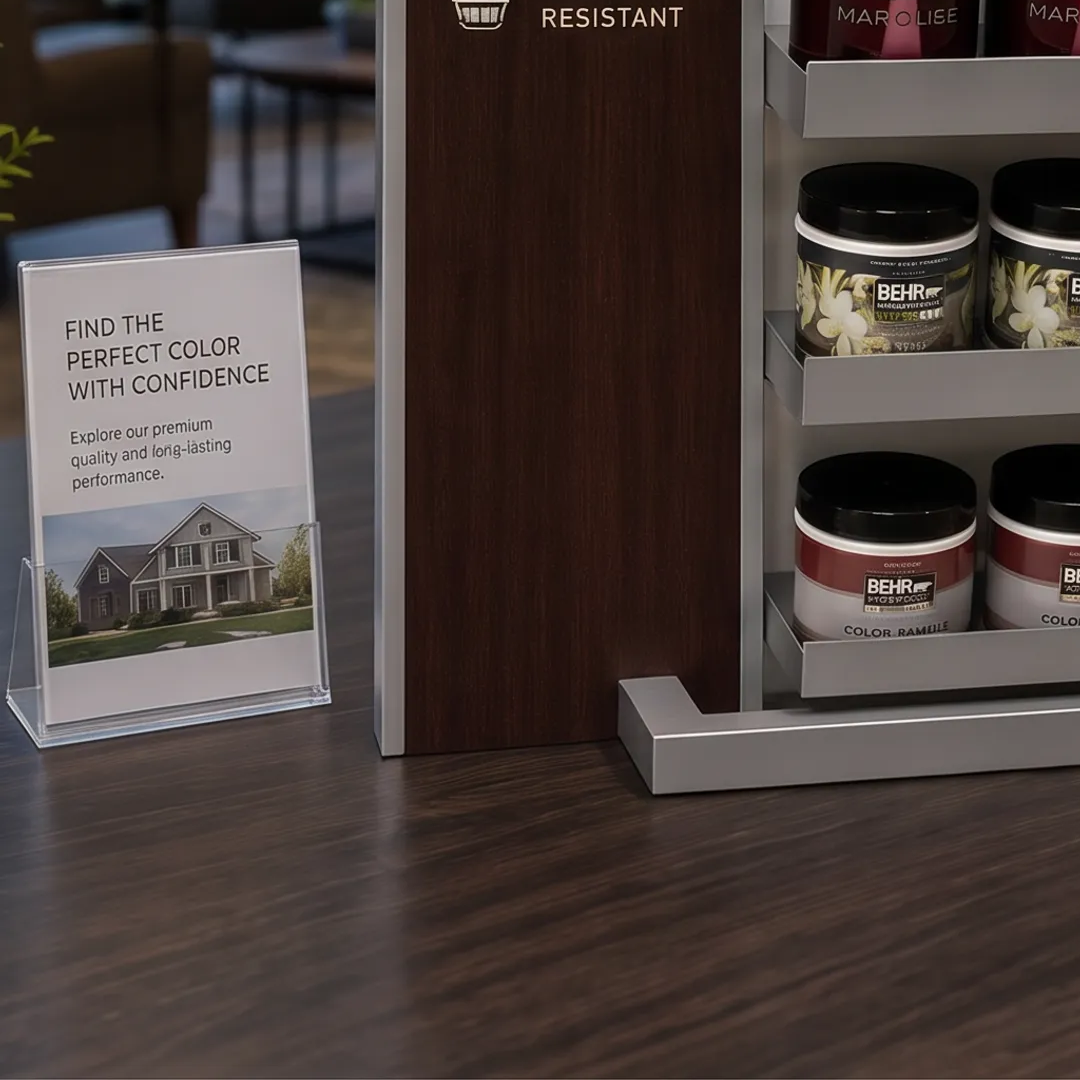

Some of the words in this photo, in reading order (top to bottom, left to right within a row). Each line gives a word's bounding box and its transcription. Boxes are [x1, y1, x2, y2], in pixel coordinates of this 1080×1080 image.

[542, 7, 684, 28] RESISTANT
[877, 283, 925, 301] BEHR
[66, 317, 115, 340] FIND
[122, 312, 164, 335] THE
[67, 343, 162, 371] PERFECT
[168, 336, 240, 360] COLOR
[68, 377, 124, 400] WITH
[132, 363, 269, 395] CONFIDENCE
[70, 428, 122, 446] Explore
[126, 425, 149, 439] our
[152, 419, 213, 439] premium
[71, 450, 118, 469] quality
[122, 446, 148, 462] and
[72, 468, 164, 492] performance.
[867, 578, 912, 595] BEHR
[844, 625, 892, 638] COLOR
